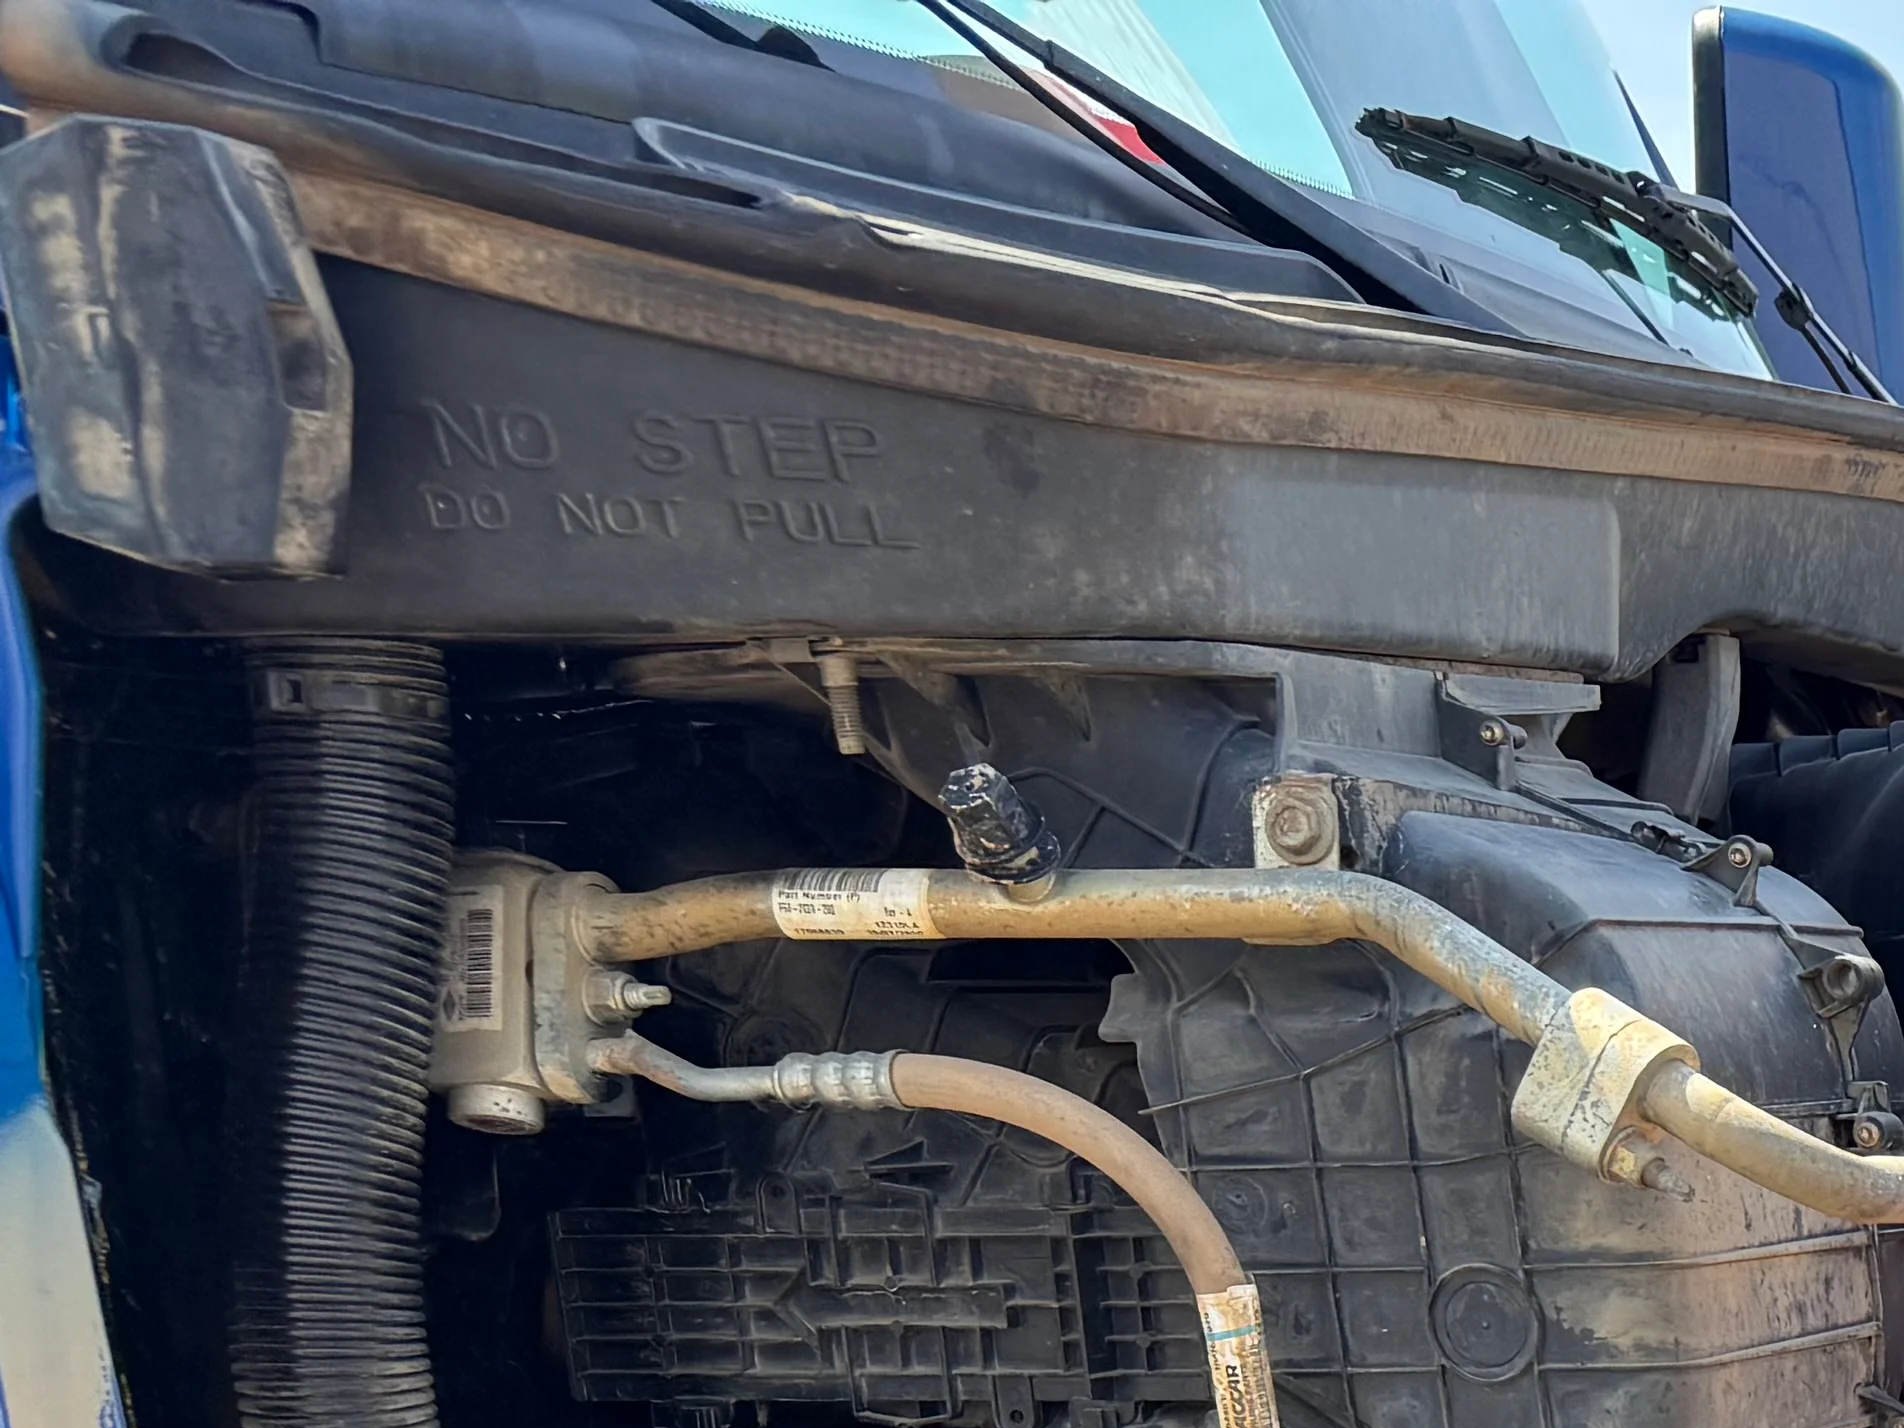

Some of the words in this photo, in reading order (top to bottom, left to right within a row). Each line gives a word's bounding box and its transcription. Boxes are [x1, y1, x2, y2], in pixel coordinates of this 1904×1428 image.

[422, 398, 564, 473] NO
[631, 412, 889, 483] STEP
[423, 486, 512, 533] DO
[559, 492, 688, 539] NOT
[738, 500, 922, 551] PULL
[803, 892, 841, 900] Number
